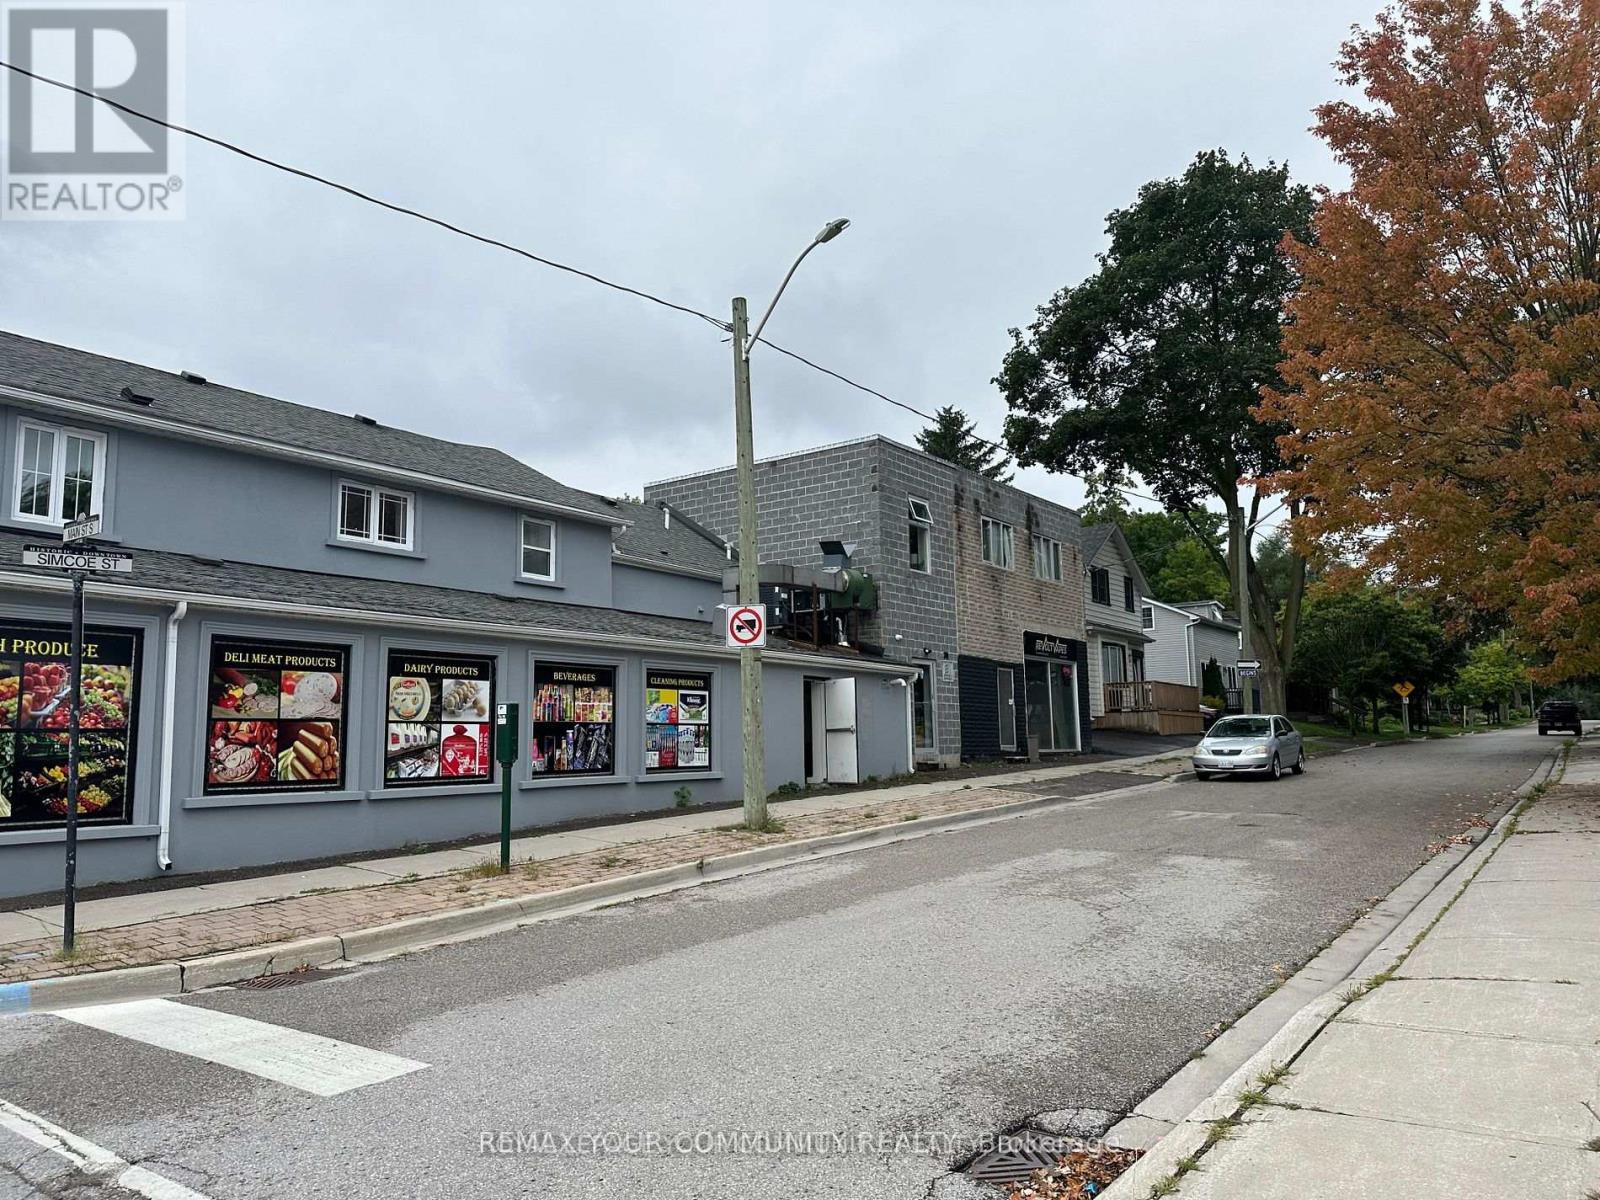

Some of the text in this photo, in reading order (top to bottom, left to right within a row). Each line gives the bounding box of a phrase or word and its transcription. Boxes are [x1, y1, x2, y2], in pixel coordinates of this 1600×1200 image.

[37, 553, 120, 570] SIMCOE ST
[223, 651, 337, 668] DELI MEAT PRODUCTS
[403, 663, 479, 676] DAIRY PRODUCTS
[553, 671, 597, 682] BEVERAGES
[650, 676, 704, 688] CLEANING PRODUCTS
